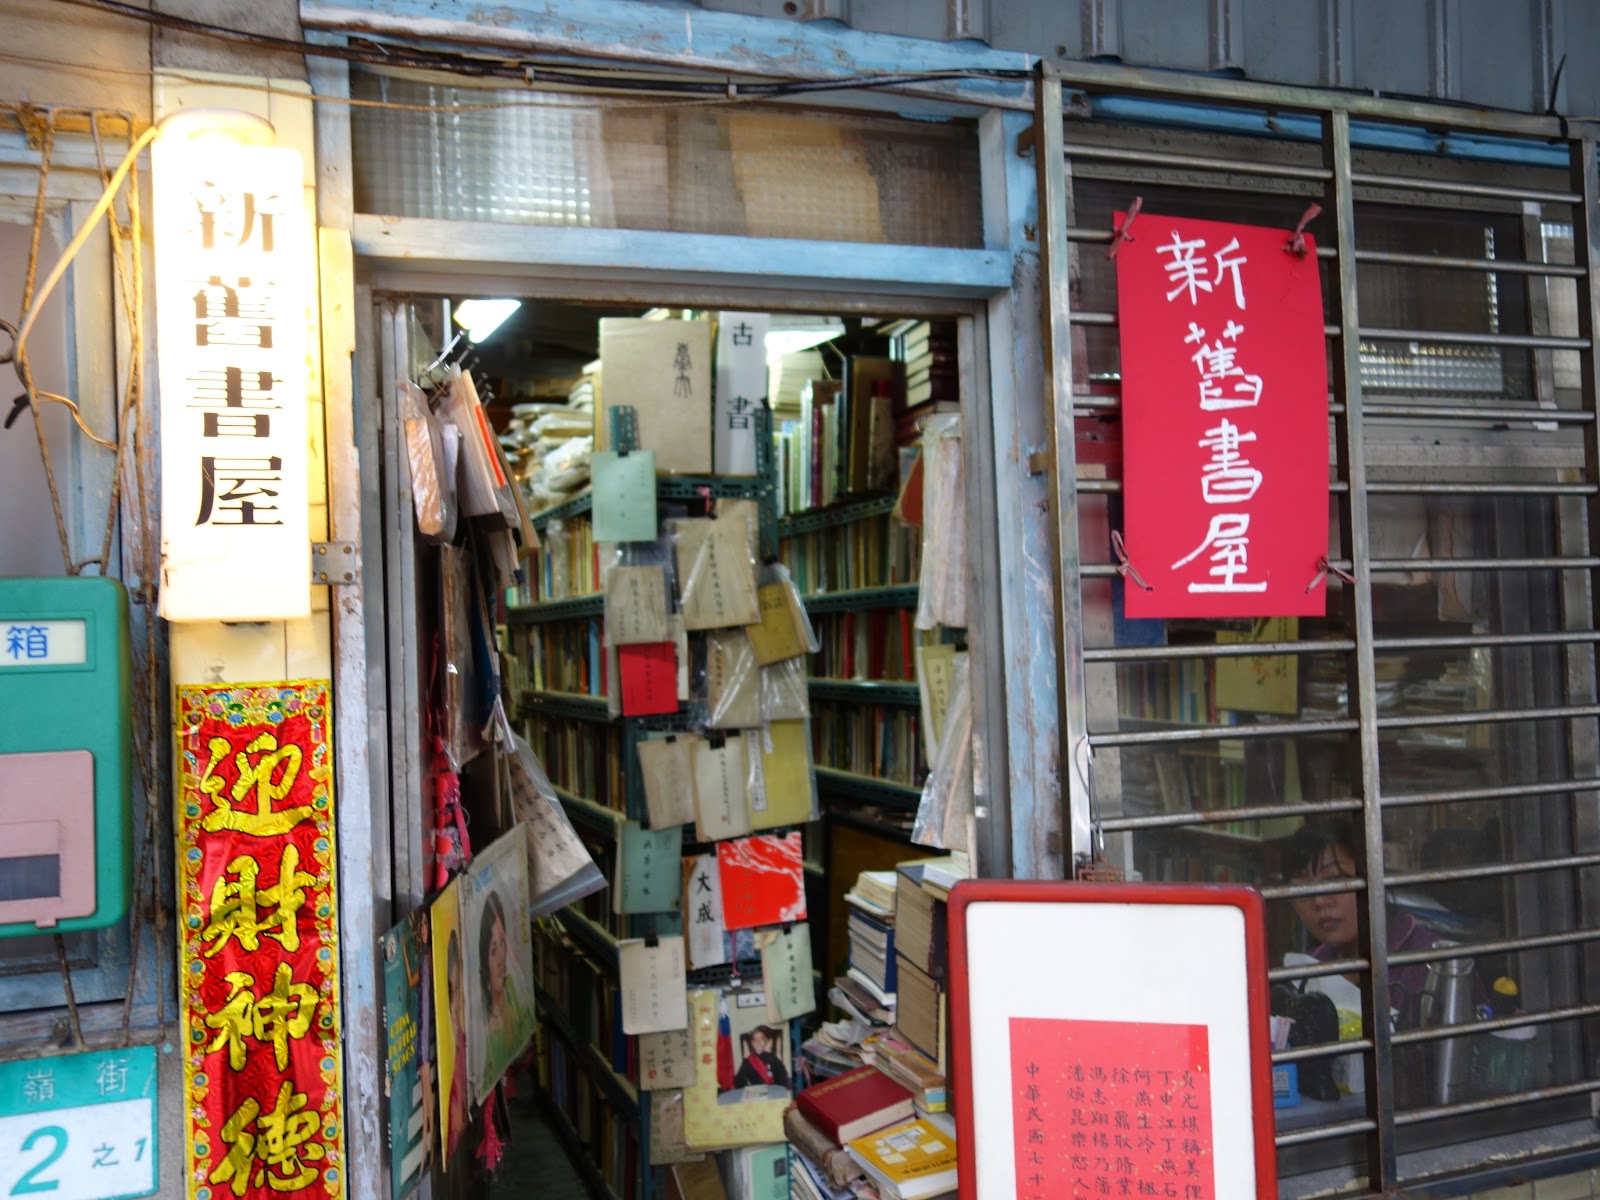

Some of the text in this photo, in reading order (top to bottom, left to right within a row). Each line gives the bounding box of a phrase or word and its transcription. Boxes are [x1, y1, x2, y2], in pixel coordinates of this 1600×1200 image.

[183, 179, 285, 527] 新舊書屋
[727, 321, 755, 430] 古書
[1156, 229, 1267, 593] 新舊書屋
[6, 624, 49, 660] 箱
[200, 731, 326, 1199] 迎財神德
[24, 1058, 129, 1103] 嶺街
